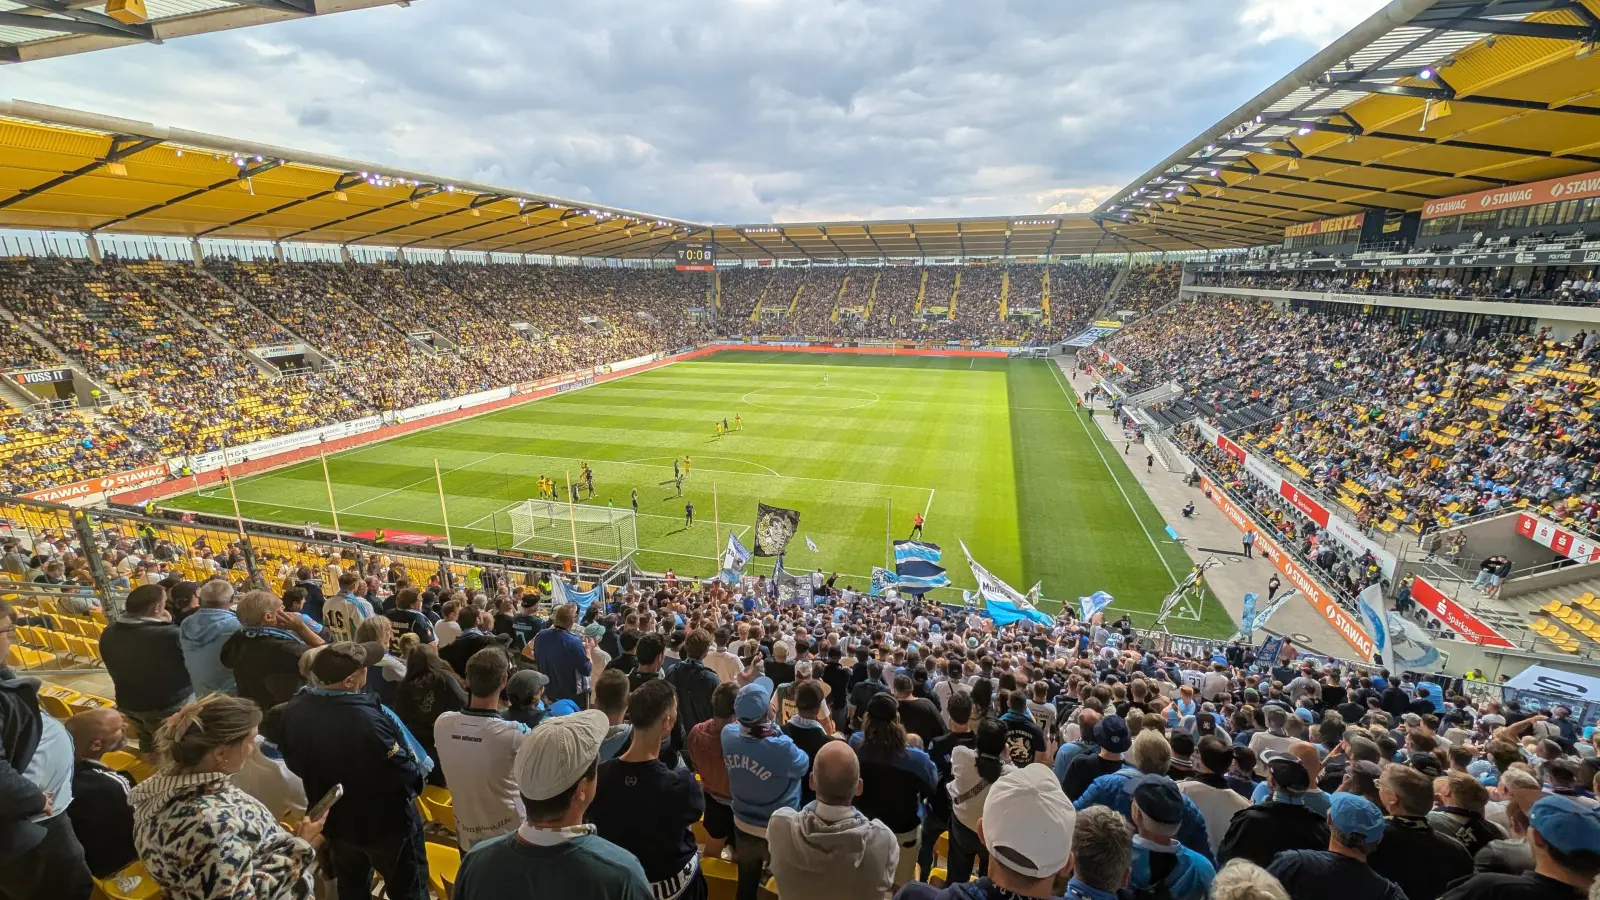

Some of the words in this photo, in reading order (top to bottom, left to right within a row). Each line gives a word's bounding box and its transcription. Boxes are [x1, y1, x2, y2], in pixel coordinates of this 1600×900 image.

[1565, 177, 1600, 195] STAW
[1490, 188, 1533, 206] STAWAG
[1434, 199, 1467, 214] STAWAG
[1286, 222, 1314, 237] WERTZ
[1320, 215, 1357, 233] WERTZ
[686, 249, 703, 260] 0:0
[1386, 258, 1403, 266] STAWAG
[24, 372, 51, 383] VOSS
[53, 370, 64, 380] IT
[355, 420, 381, 428] FRINGS
[210, 449, 249, 462] FRNGS
[116, 467, 164, 485] STAWAG
[33, 483, 90, 502] STAWAG
[1258, 537, 1280, 563] STAWAG
[1292, 569, 1319, 603] STAWAG
[326, 609, 344, 629] 16
[1447, 612, 1480, 641] Sparkasse
[1335, 613, 1372, 656] STAWAG
